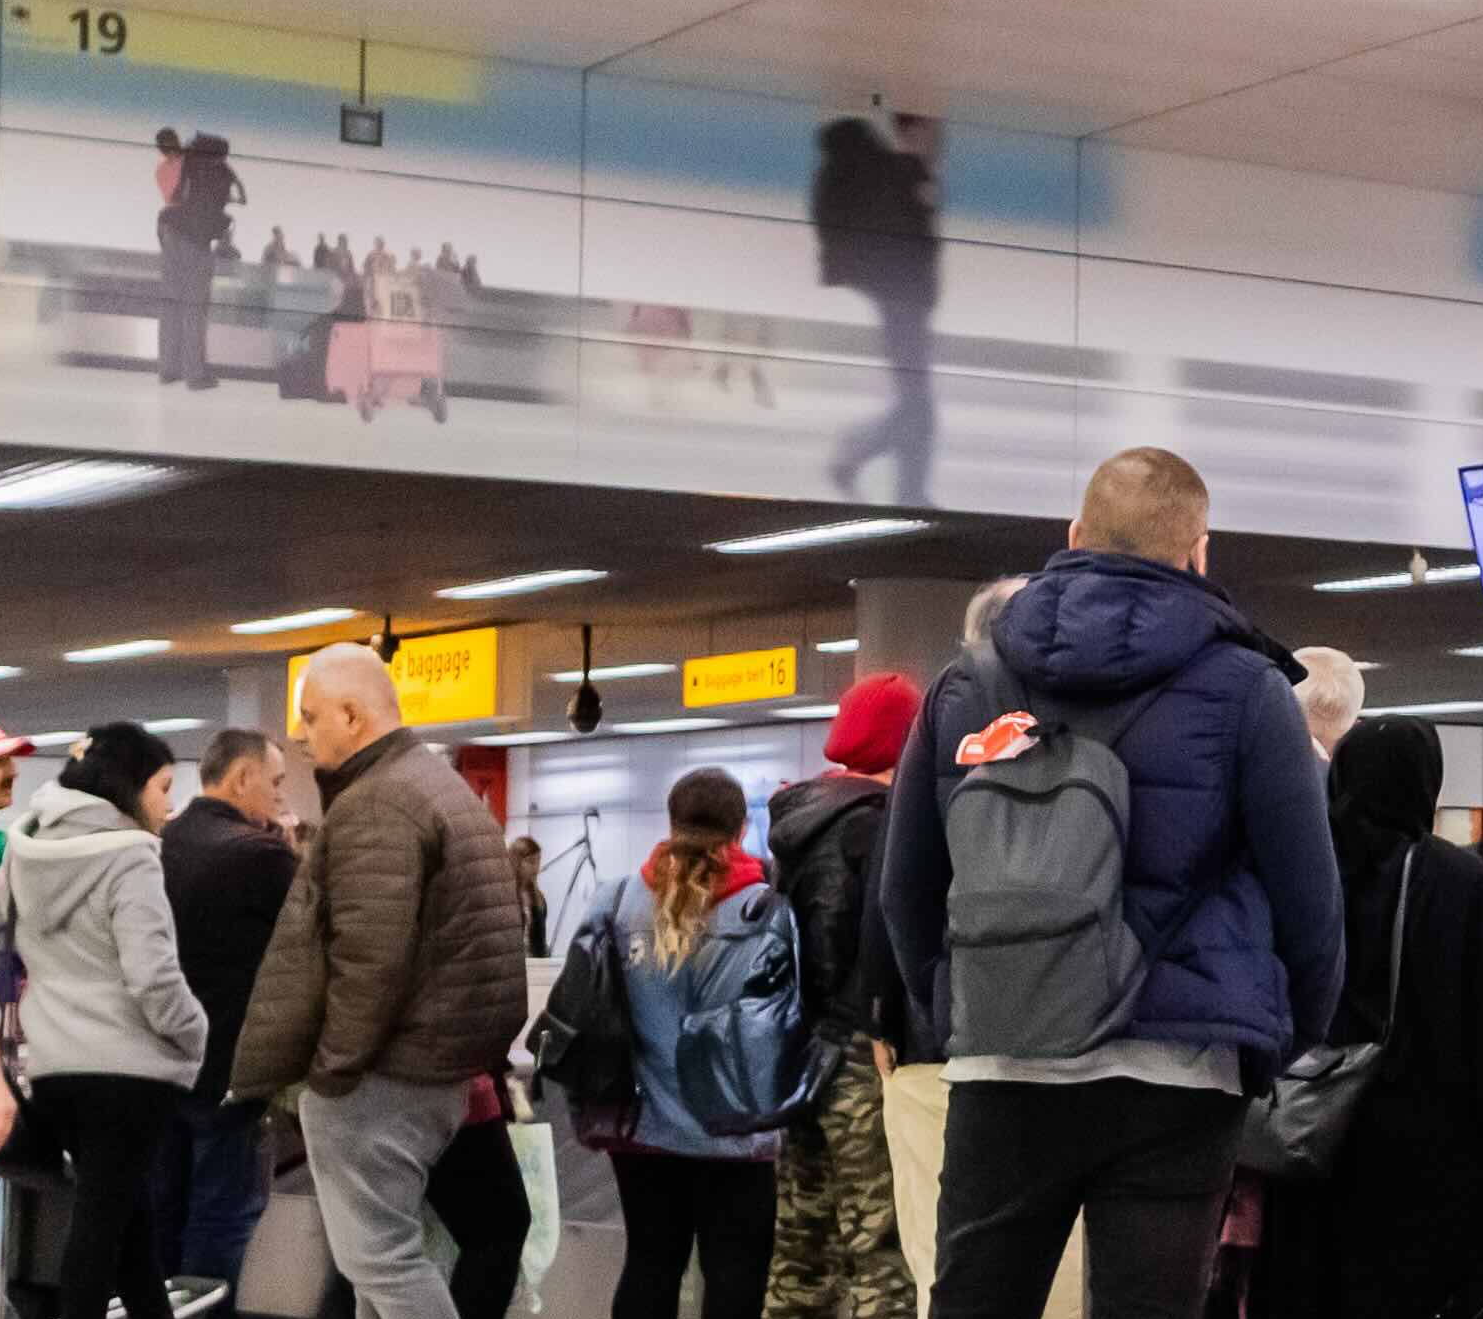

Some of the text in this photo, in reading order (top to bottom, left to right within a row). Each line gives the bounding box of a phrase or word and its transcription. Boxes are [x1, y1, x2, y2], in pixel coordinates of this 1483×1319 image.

[69, 8, 127, 55] 19
[407, 649, 471, 683] baggage
[768, 657, 786, 686] 16
